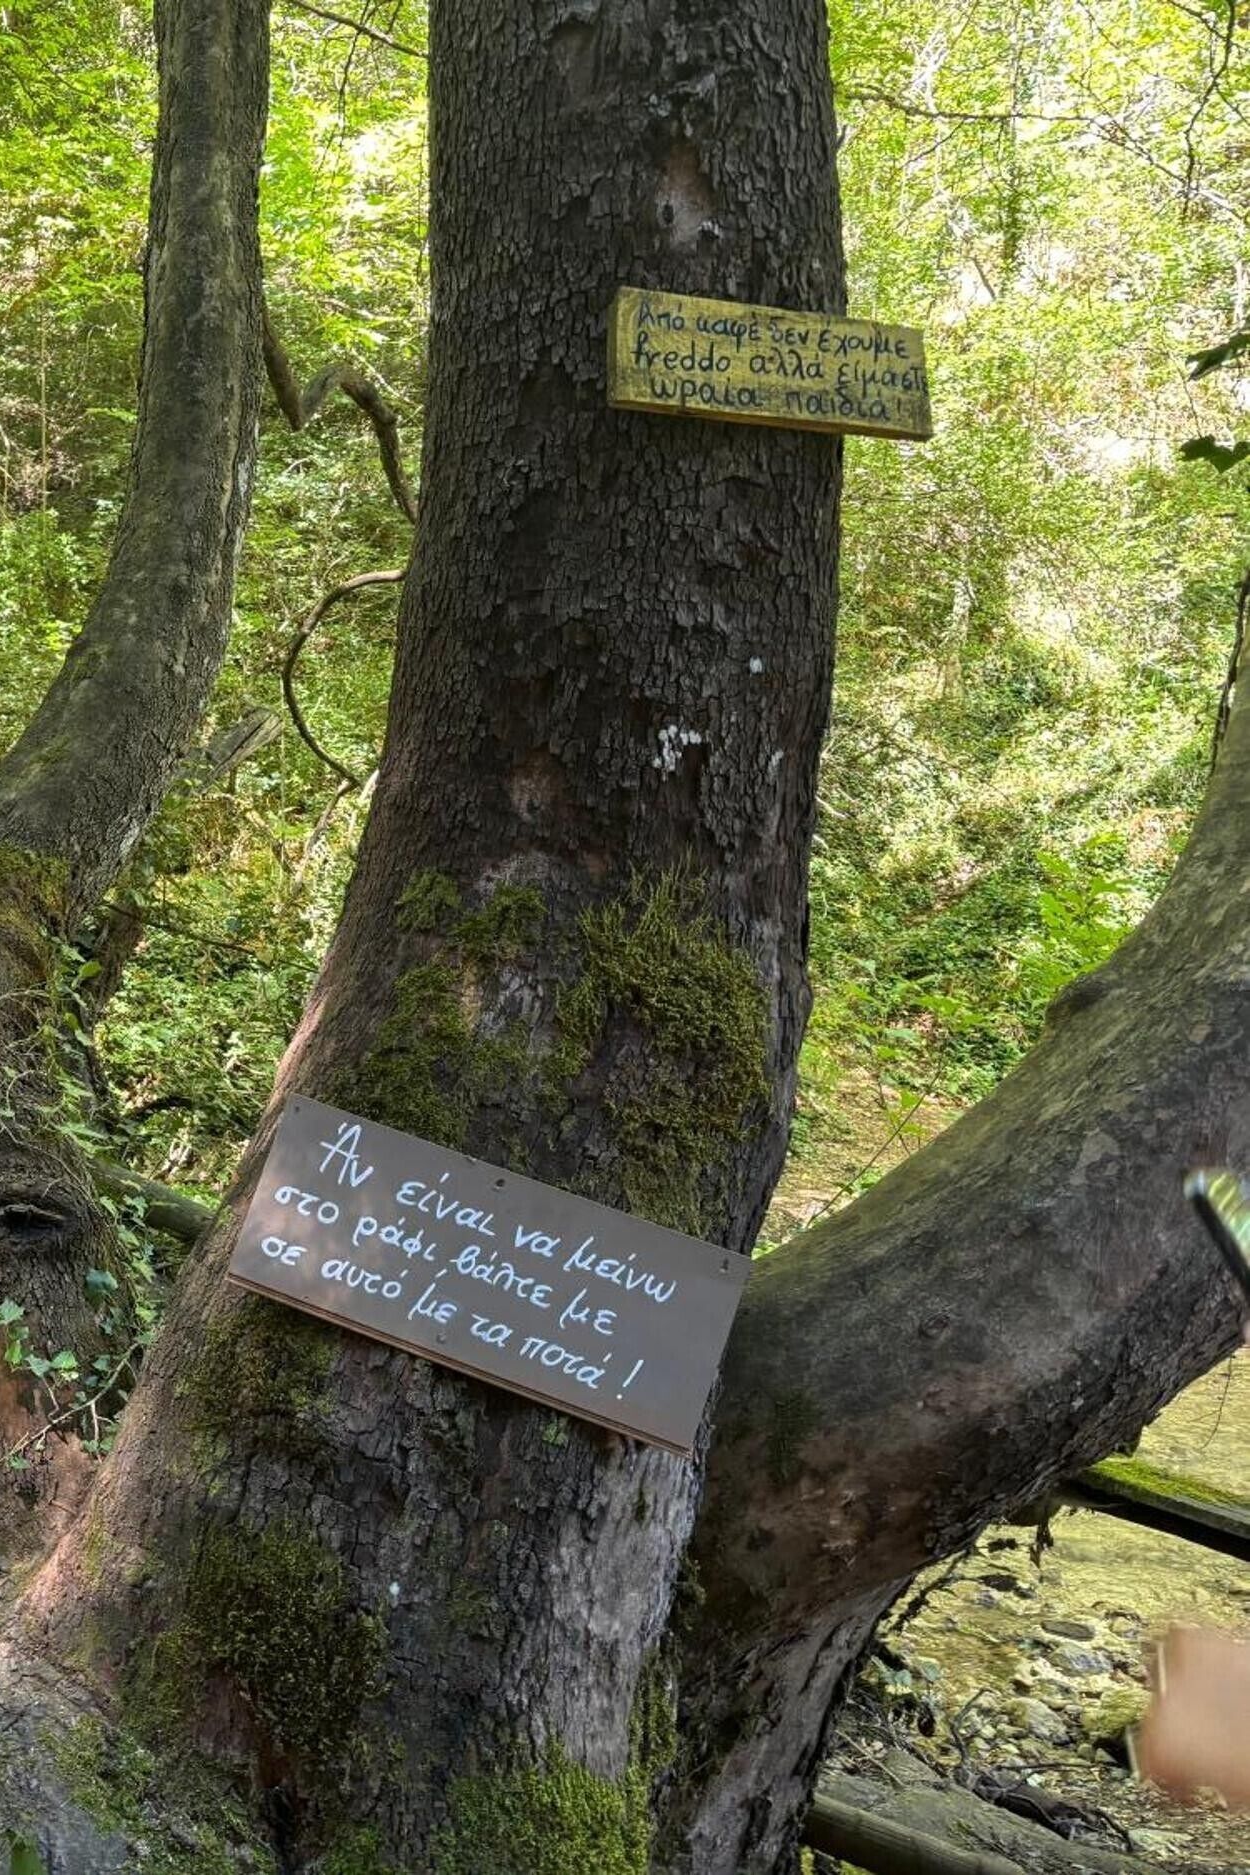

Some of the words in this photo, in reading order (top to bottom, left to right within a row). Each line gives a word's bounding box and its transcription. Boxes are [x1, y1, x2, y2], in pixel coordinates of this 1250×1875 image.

[260, 1235, 308, 1267] σε
[321, 1254, 408, 1300] αυτό
[470, 1312, 514, 1348] τα
[274, 1184, 340, 1225] στο
[450, 1245, 553, 1309] βάλτε
[559, 1289, 620, 1335] με
[396, 1172, 496, 1237] είναι
[513, 1225, 562, 1258] να
[564, 1236, 678, 1304] μείνω
